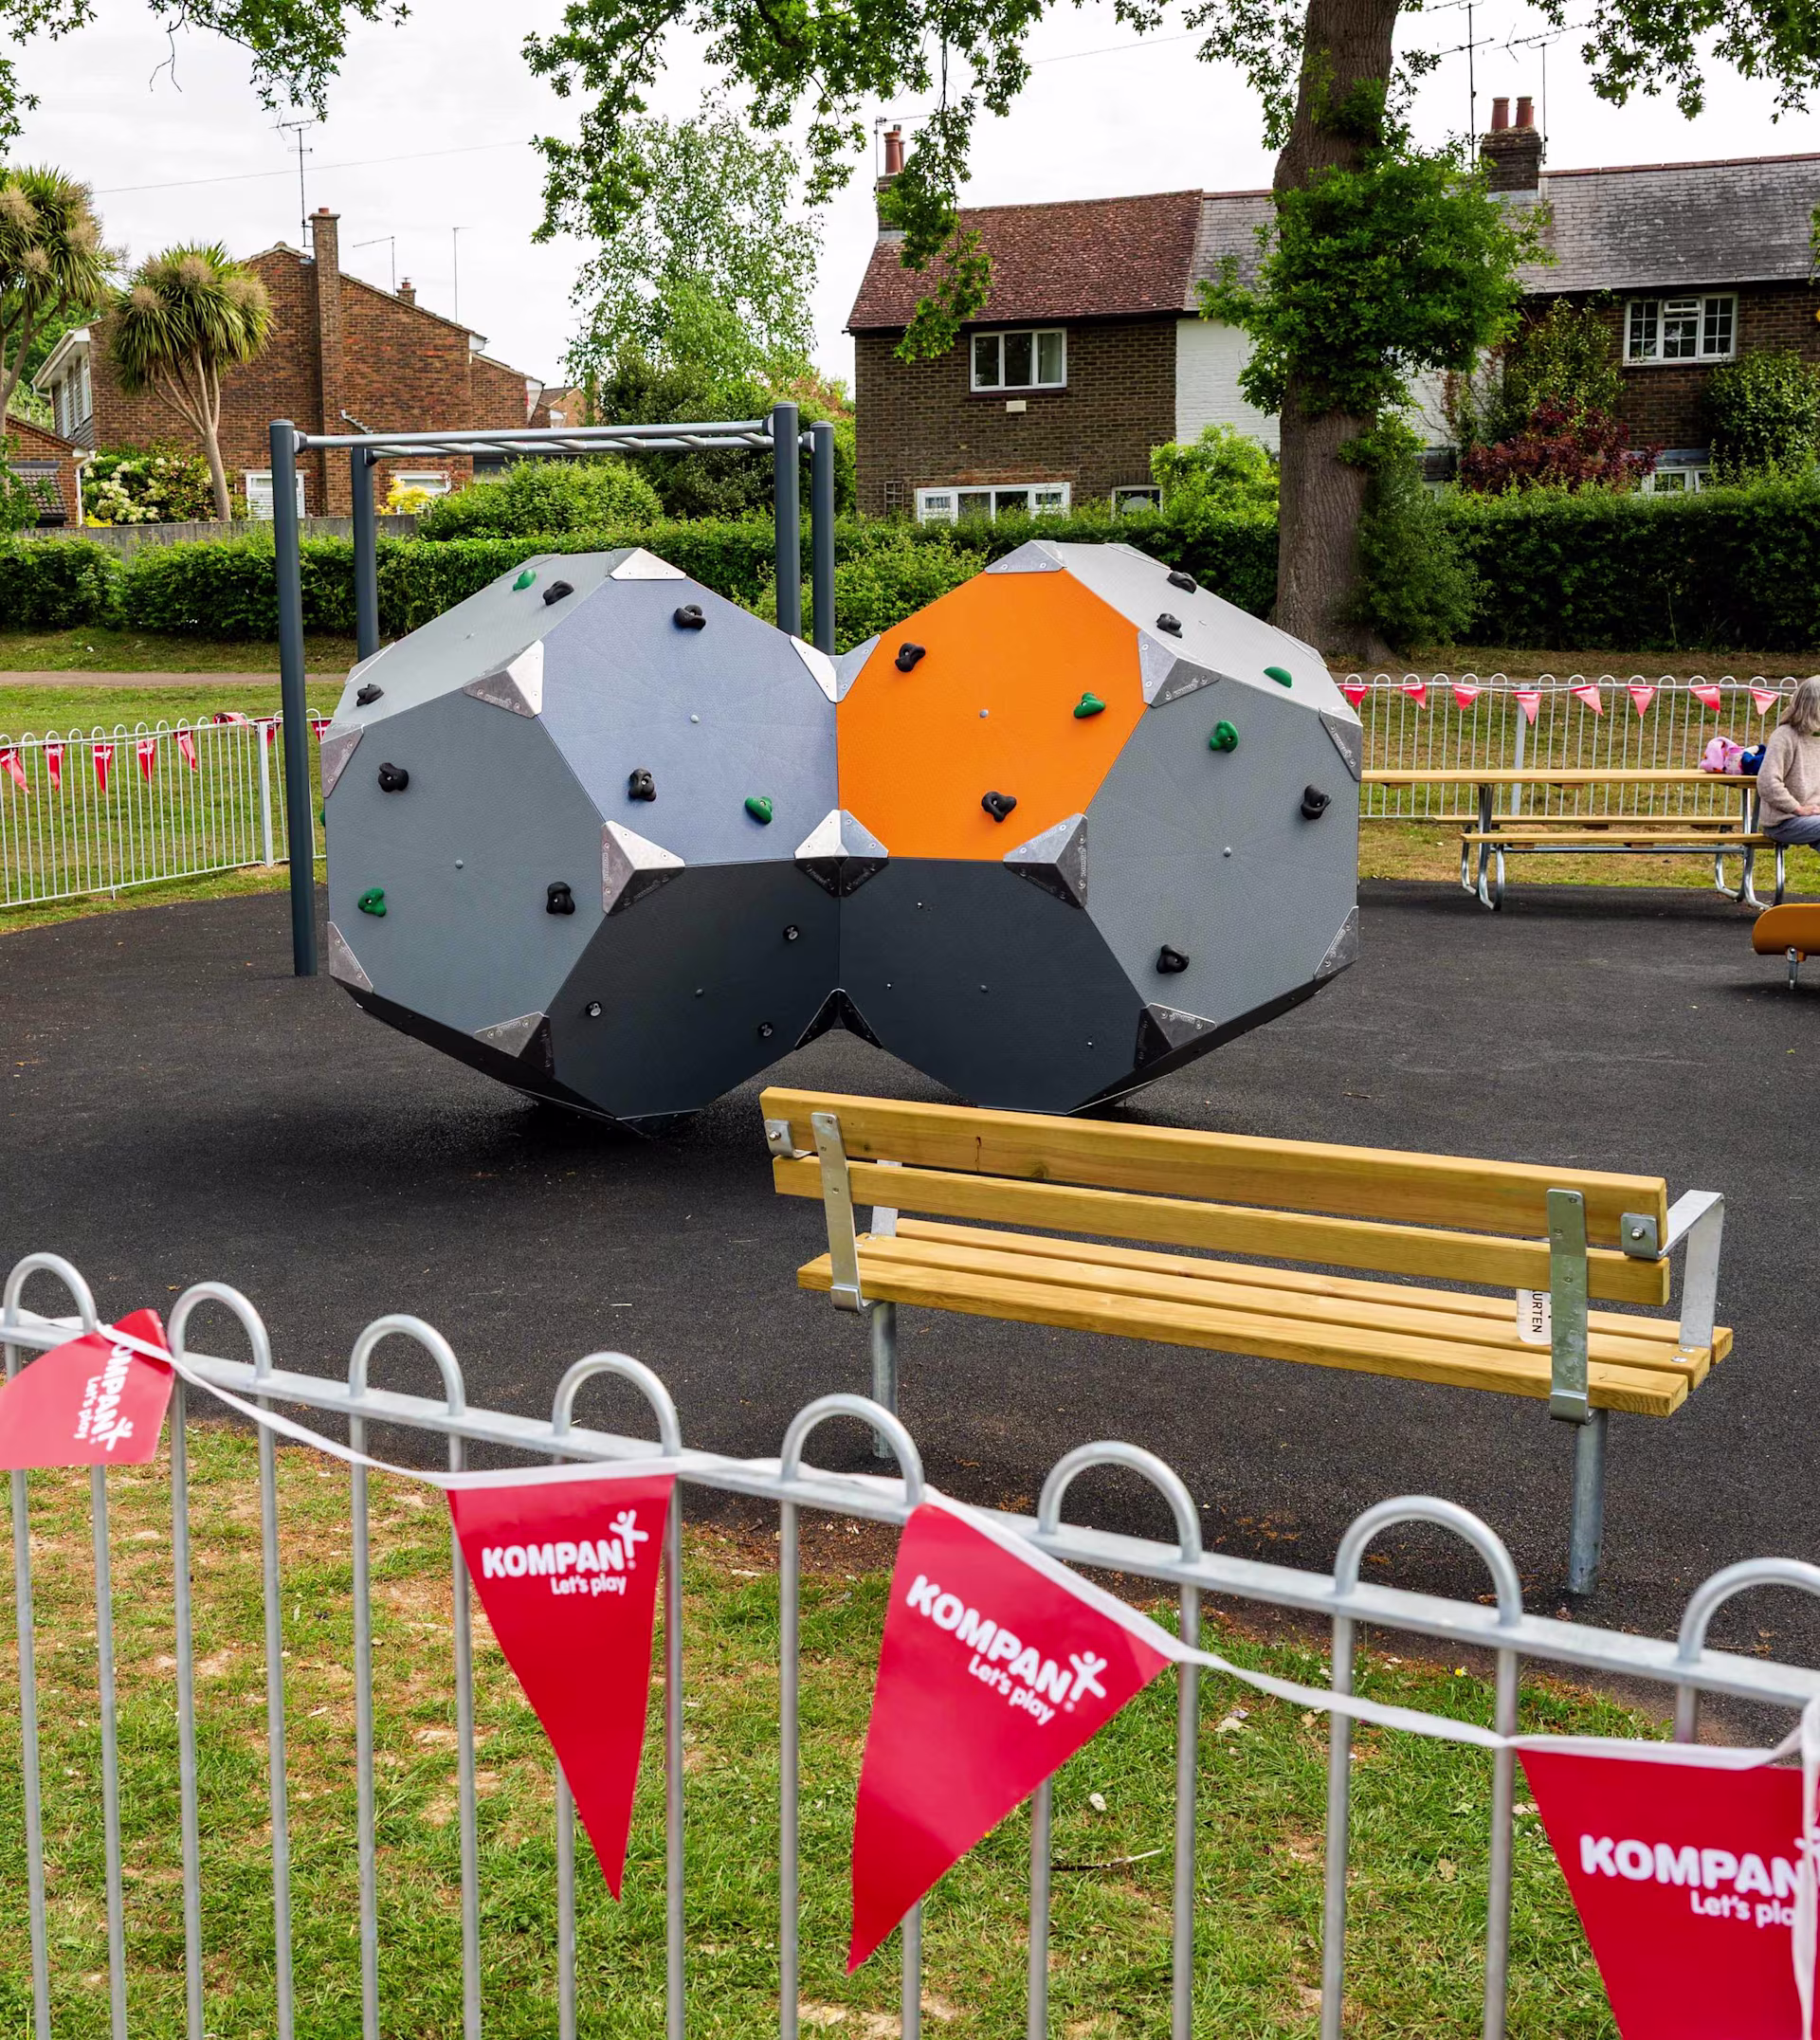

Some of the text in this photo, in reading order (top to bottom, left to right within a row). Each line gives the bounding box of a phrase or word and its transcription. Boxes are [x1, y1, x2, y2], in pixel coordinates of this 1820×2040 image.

[1532, 1290, 1543, 1333] URTEN
[74, 1376, 102, 1439] Let's play
[91, 1344, 134, 1434] OMPAN
[482, 1539, 625, 1578] KOMPAN
[551, 1573, 627, 1597] Let's play
[906, 1575, 1073, 1703] KOMPAN
[969, 1654, 1055, 1726] Let's play
[1690, 1890, 1795, 1929] Let's pla
